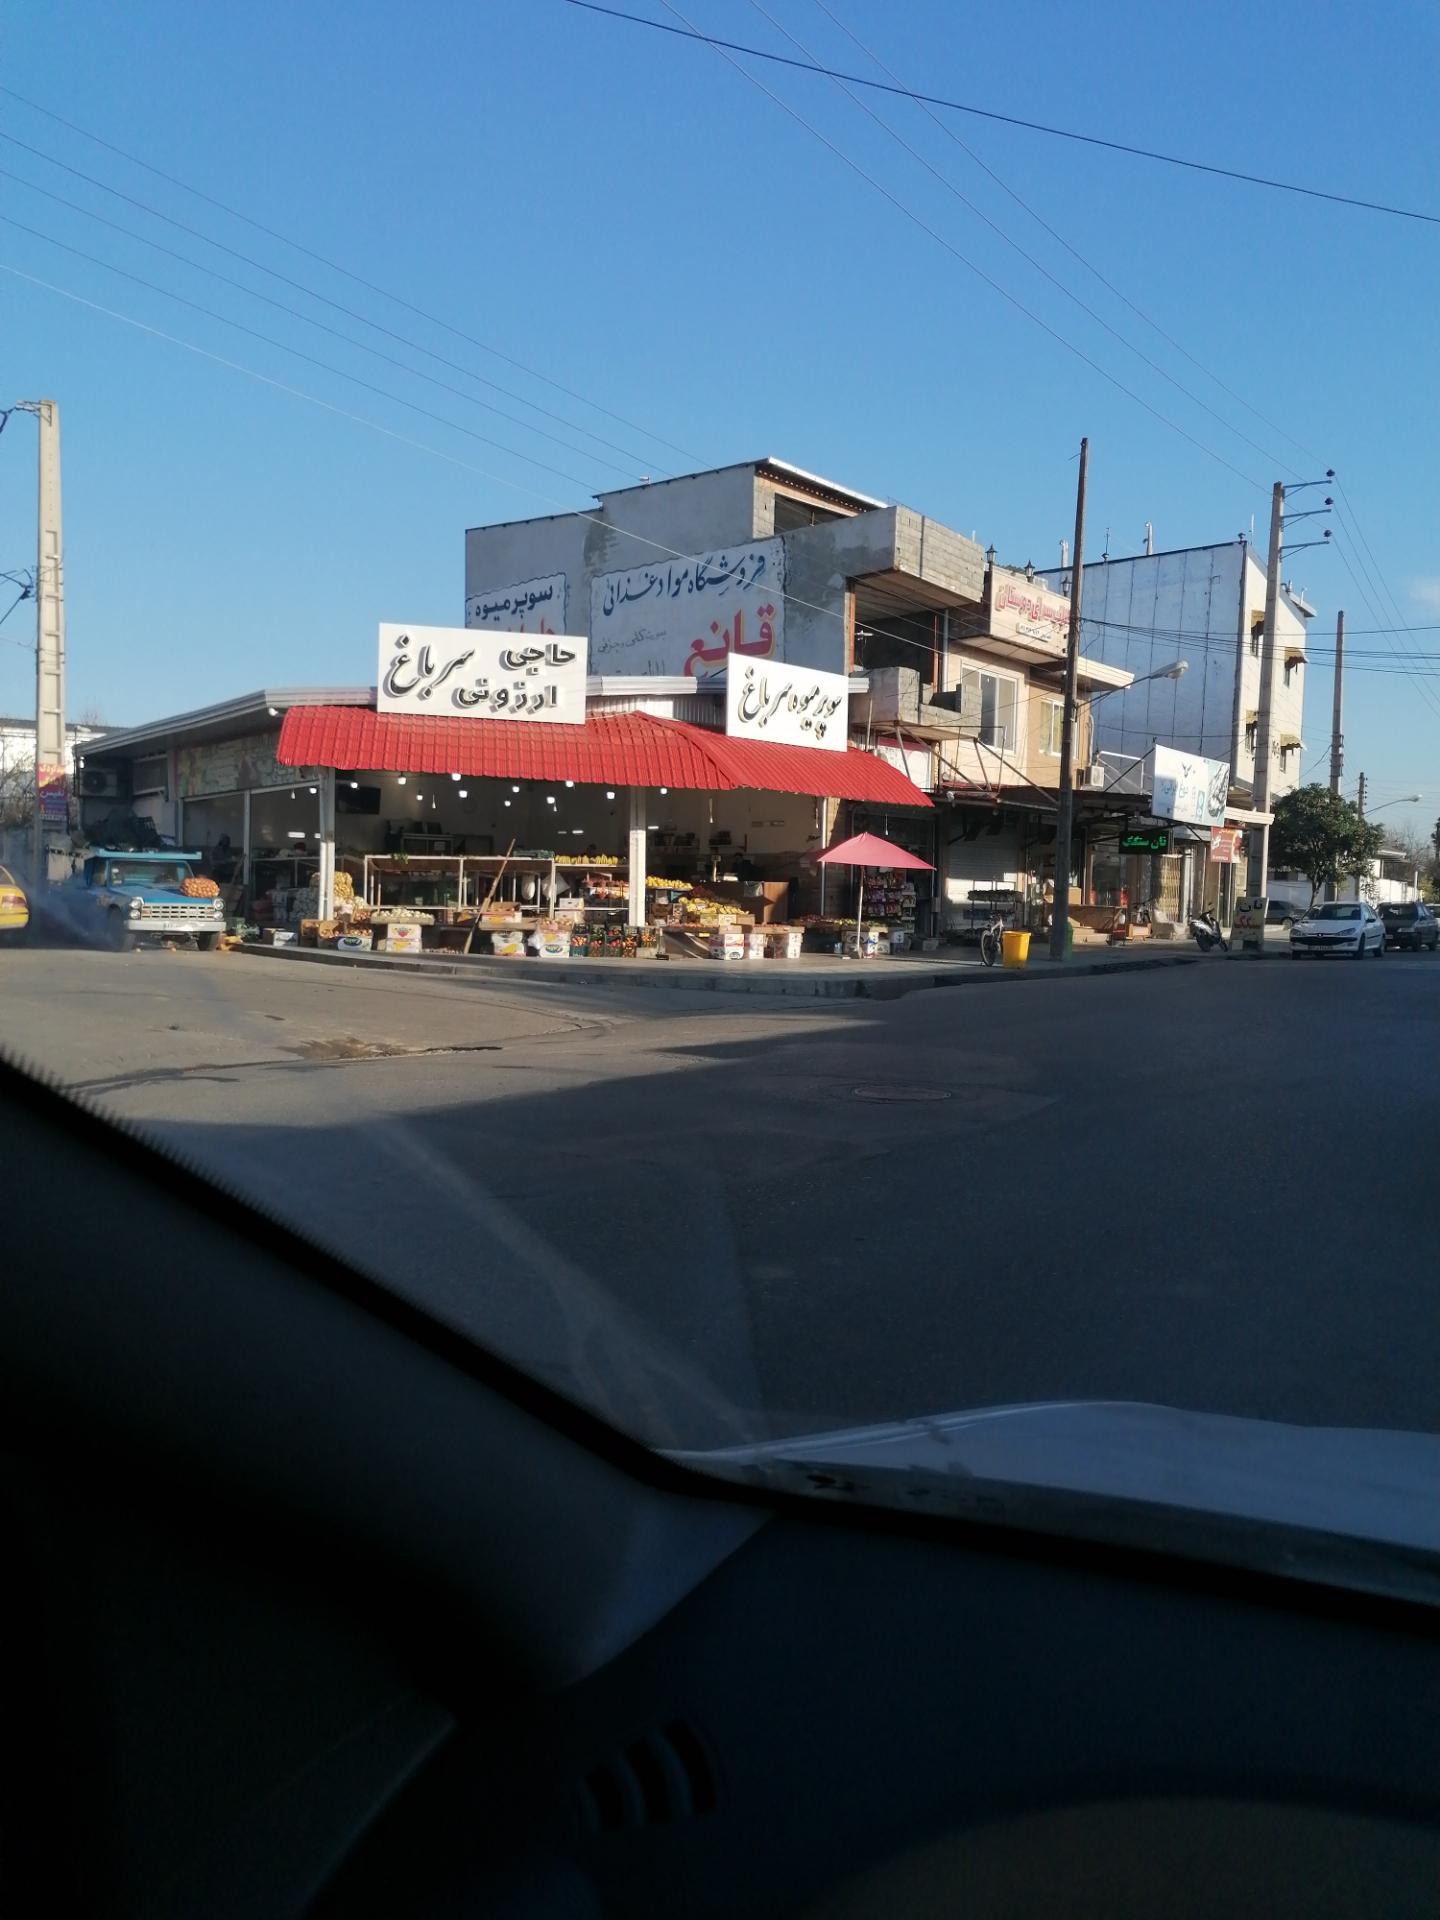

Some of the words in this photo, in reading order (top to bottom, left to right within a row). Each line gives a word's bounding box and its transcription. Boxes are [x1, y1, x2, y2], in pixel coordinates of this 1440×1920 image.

[656, 565, 688, 598] مواد
[688, 555, 766, 597] فروشگاه
[501, 643, 576, 676] حاجی
